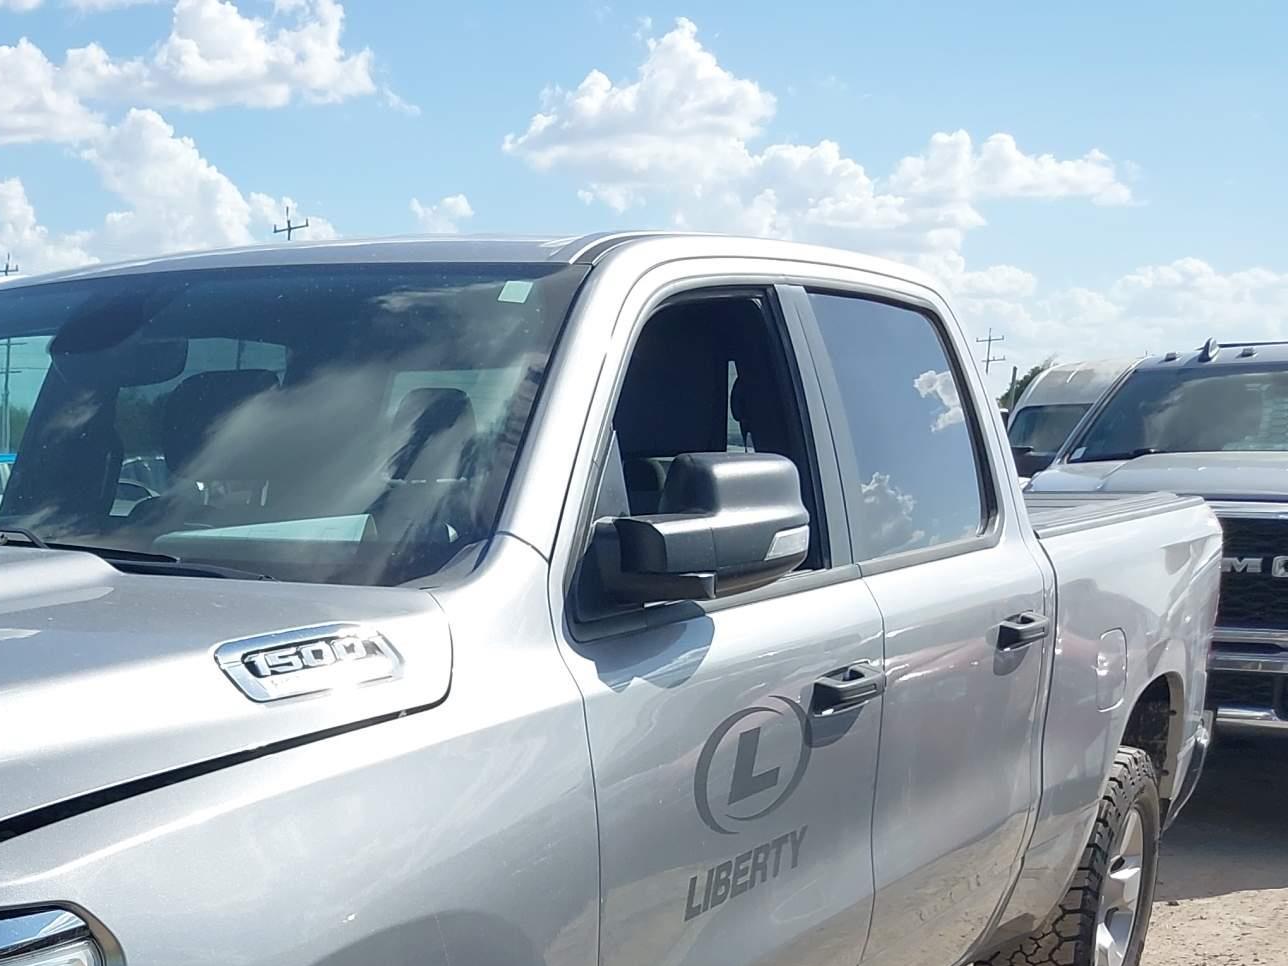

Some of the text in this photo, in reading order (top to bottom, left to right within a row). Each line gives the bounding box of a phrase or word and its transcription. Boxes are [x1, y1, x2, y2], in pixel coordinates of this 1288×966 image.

[246, 634, 372, 677] 1500
[728, 726, 781, 806] L
[684, 824, 809, 922] LIBERTY
